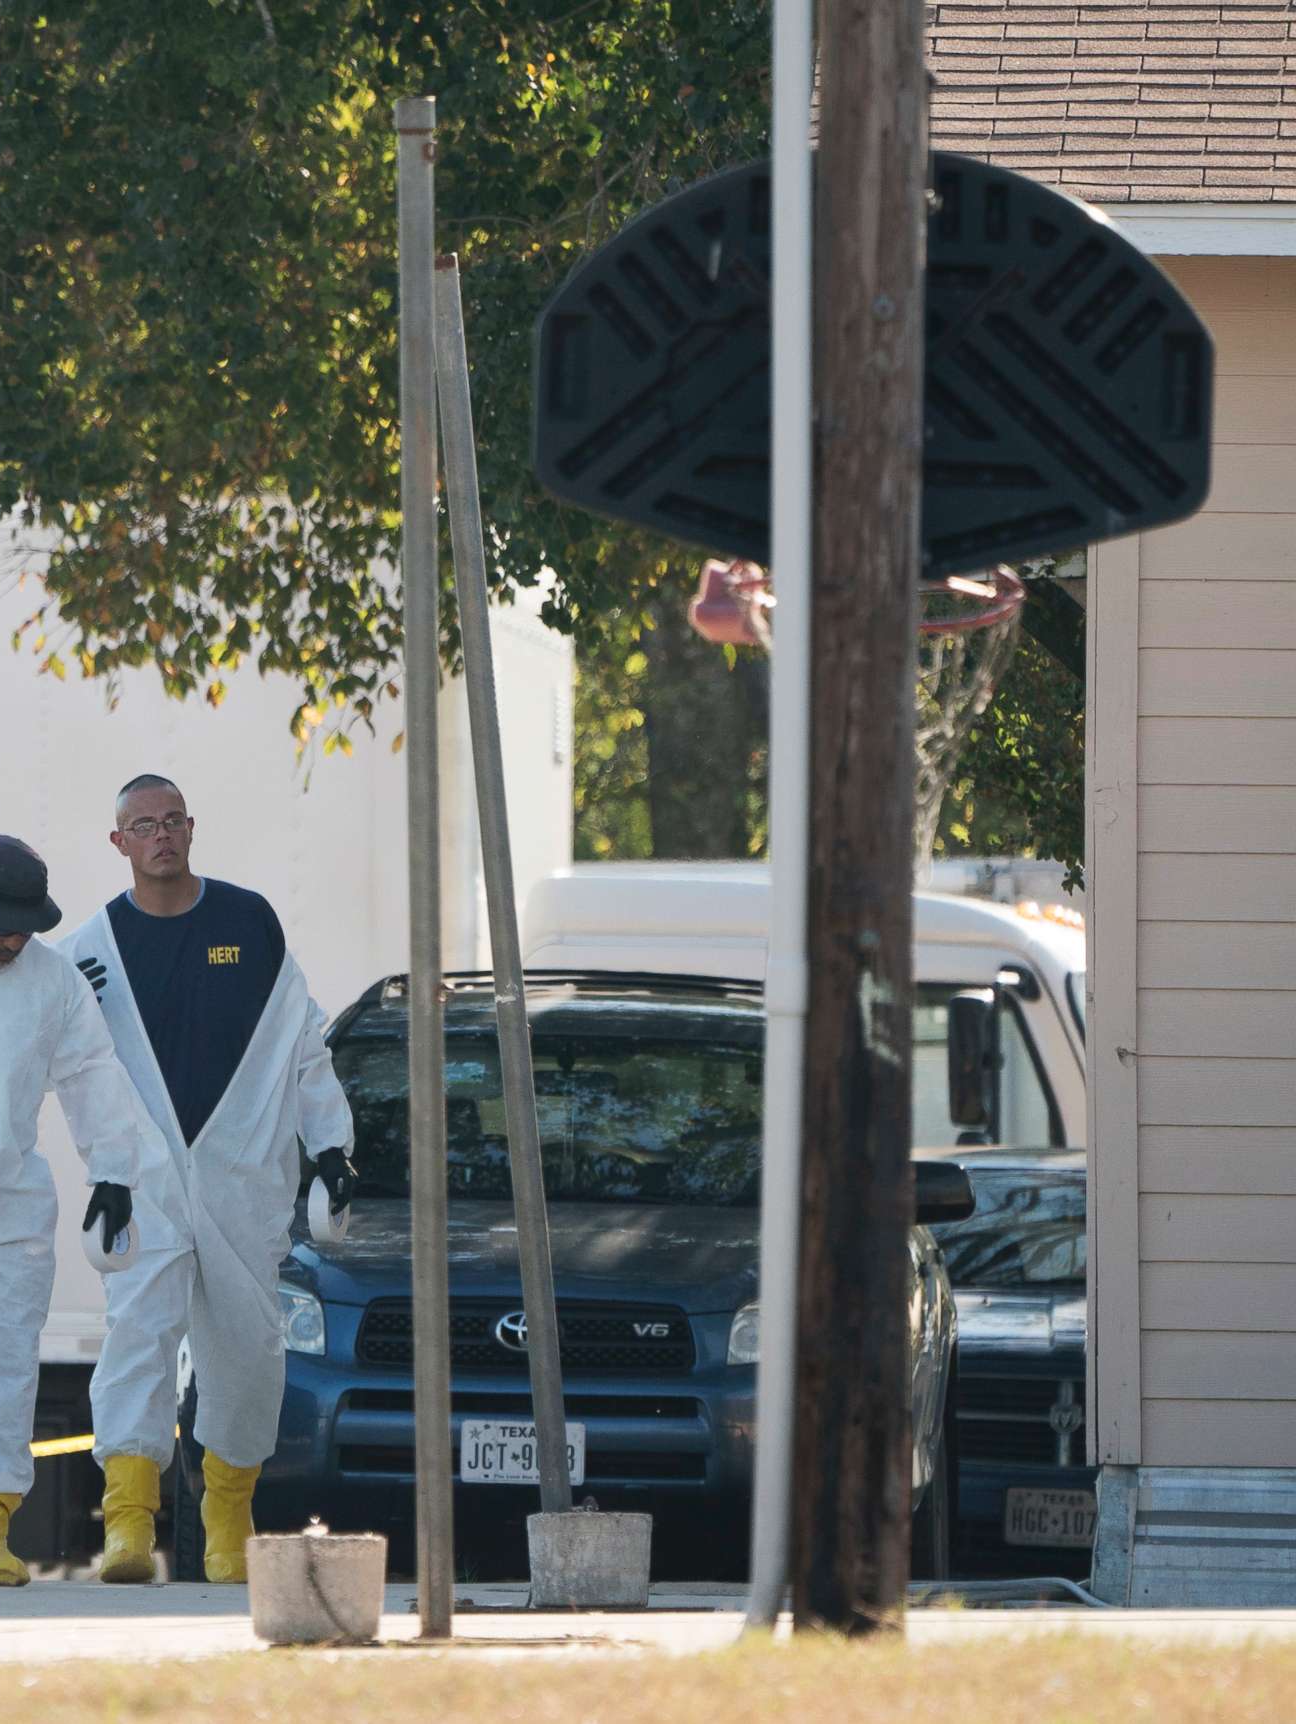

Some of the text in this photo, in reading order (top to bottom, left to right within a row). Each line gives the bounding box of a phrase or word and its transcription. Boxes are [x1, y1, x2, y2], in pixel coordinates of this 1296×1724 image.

[208, 946, 240, 964] HERT
[633, 1323, 669, 1336] V6
[500, 1426, 537, 1438] TEXA
